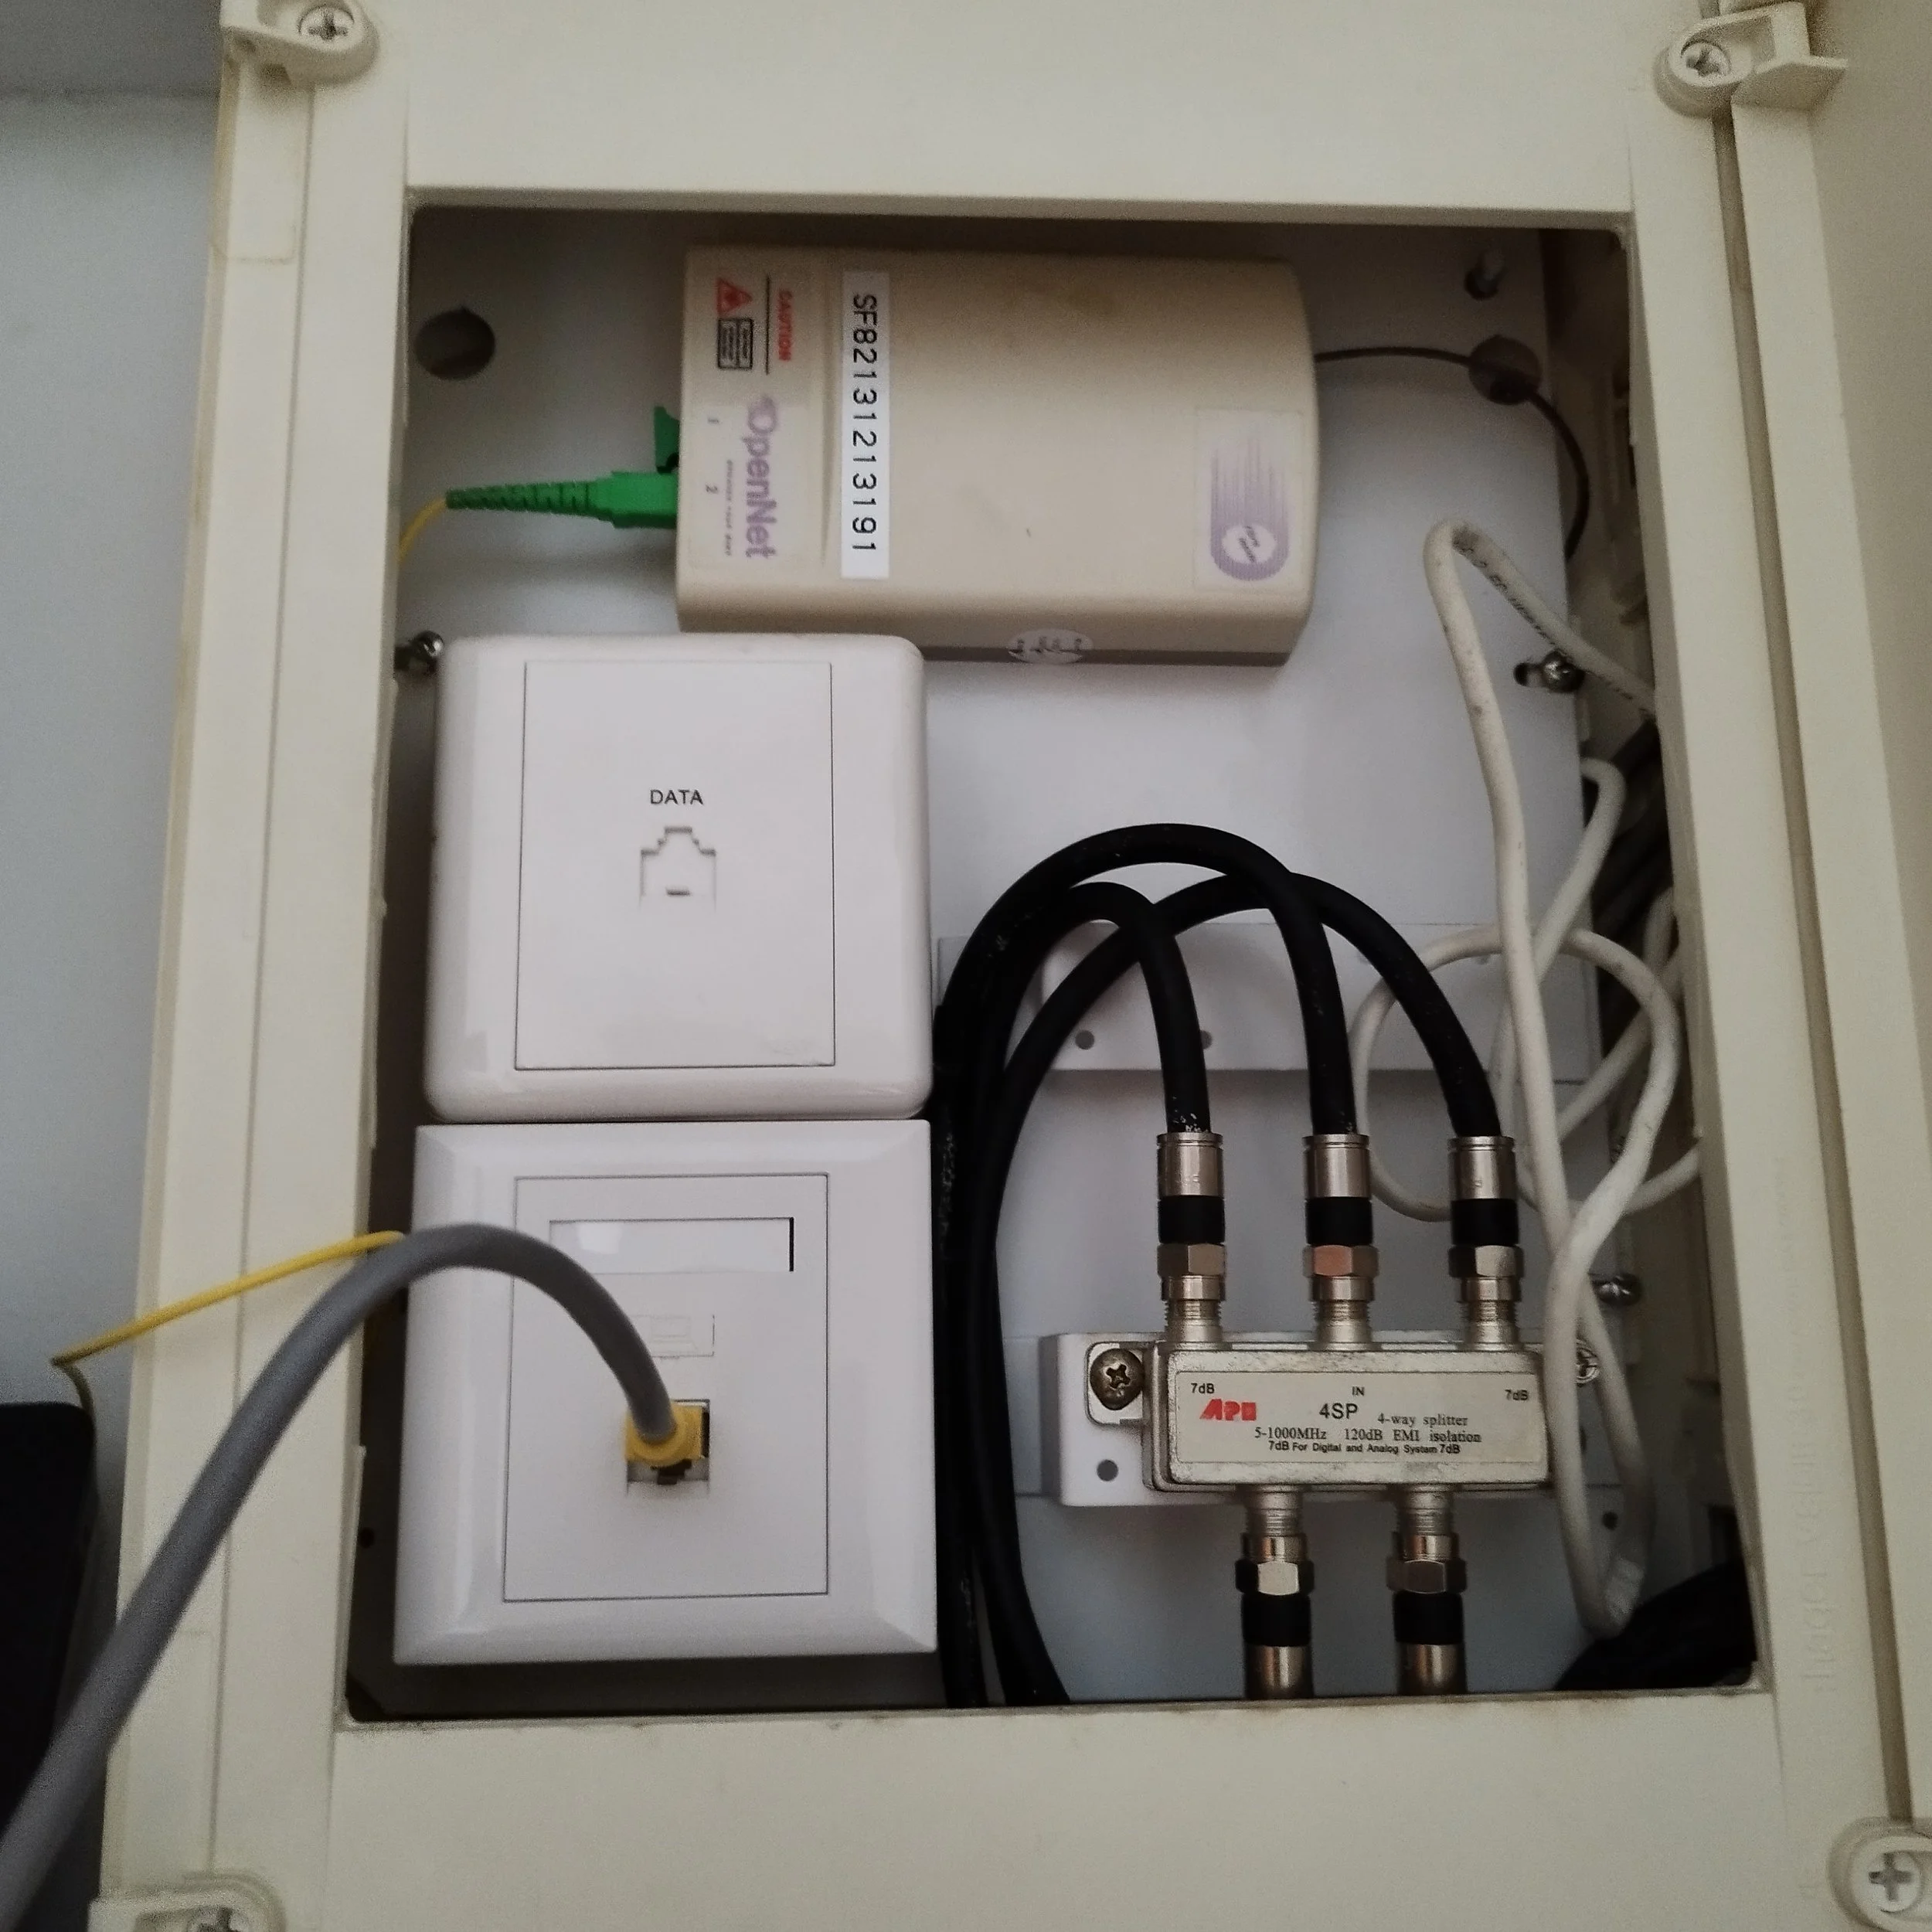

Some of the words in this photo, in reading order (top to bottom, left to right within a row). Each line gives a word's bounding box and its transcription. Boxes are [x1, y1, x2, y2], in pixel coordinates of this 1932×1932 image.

[778, 289, 793, 361] CAUTION
[741, 394, 777, 559] OpenNet
[650, 789, 703, 805] DATA
[1191, 1383, 1215, 1394] 7dB
[1352, 1386, 1366, 1396] IN
[1505, 1389, 1529, 1401] 7dB
[1318, 1403, 1359, 1420] 4SP
[1377, 1413, 1416, 1427] 4-way
[1423, 1413, 1468, 1427] splitter
[1254, 1427, 1327, 1440] 5-1000MHz
[1345, 1428, 1383, 1441] 120dB
[1393, 1430, 1420, 1442] EMI
[1429, 1430, 1482, 1443] isolation
[1268, 1440, 1290, 1451] 7dB
[1292, 1442, 1308, 1452] For
[1312, 1443, 1342, 1454] Digital
[1346, 1444, 1364, 1453] and
[1366, 1444, 1400, 1454] Analog
[1403, 1444, 1437, 1455] System
[1439, 1444, 1461, 1454] 7dB
